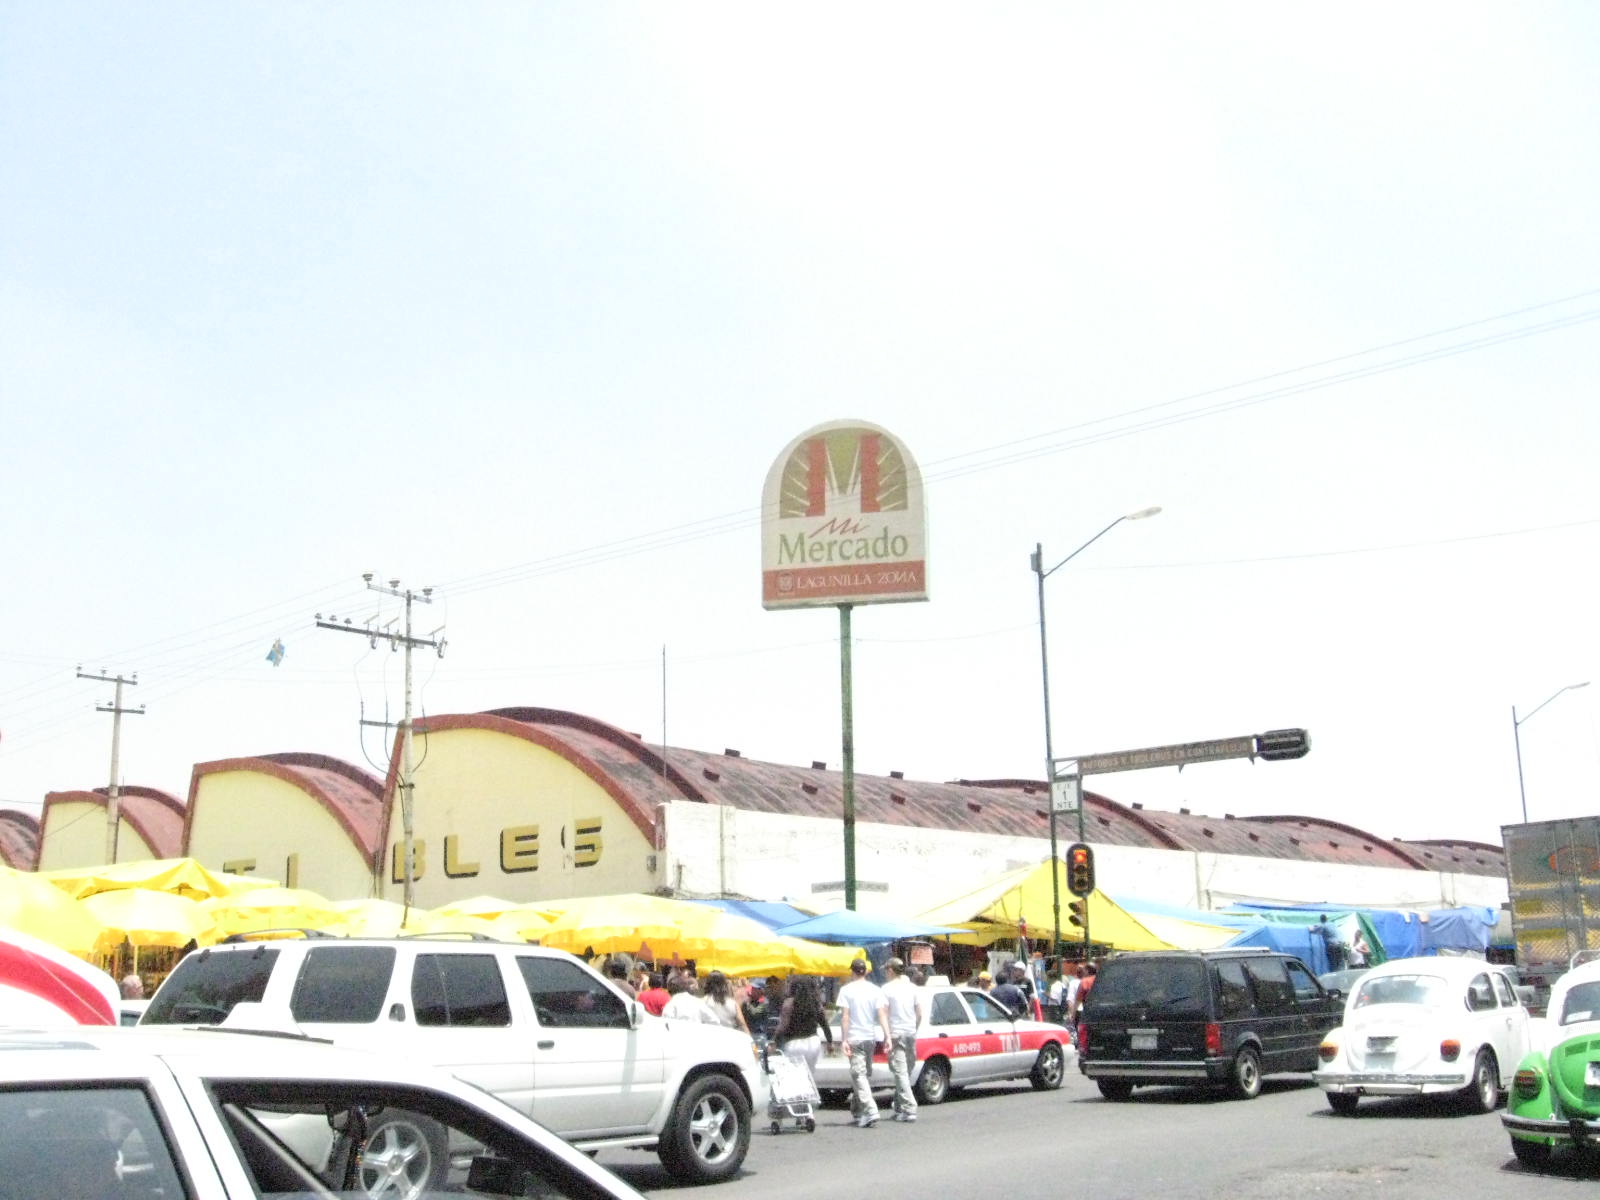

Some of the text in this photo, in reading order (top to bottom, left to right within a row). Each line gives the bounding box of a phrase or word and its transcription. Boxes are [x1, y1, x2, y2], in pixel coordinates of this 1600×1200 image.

[808, 517, 870, 538] Mi
[777, 526, 908, 565] Mercado
[797, 573, 872, 589] LAGUNILLA
[1056, 801, 1073, 809] NTE
